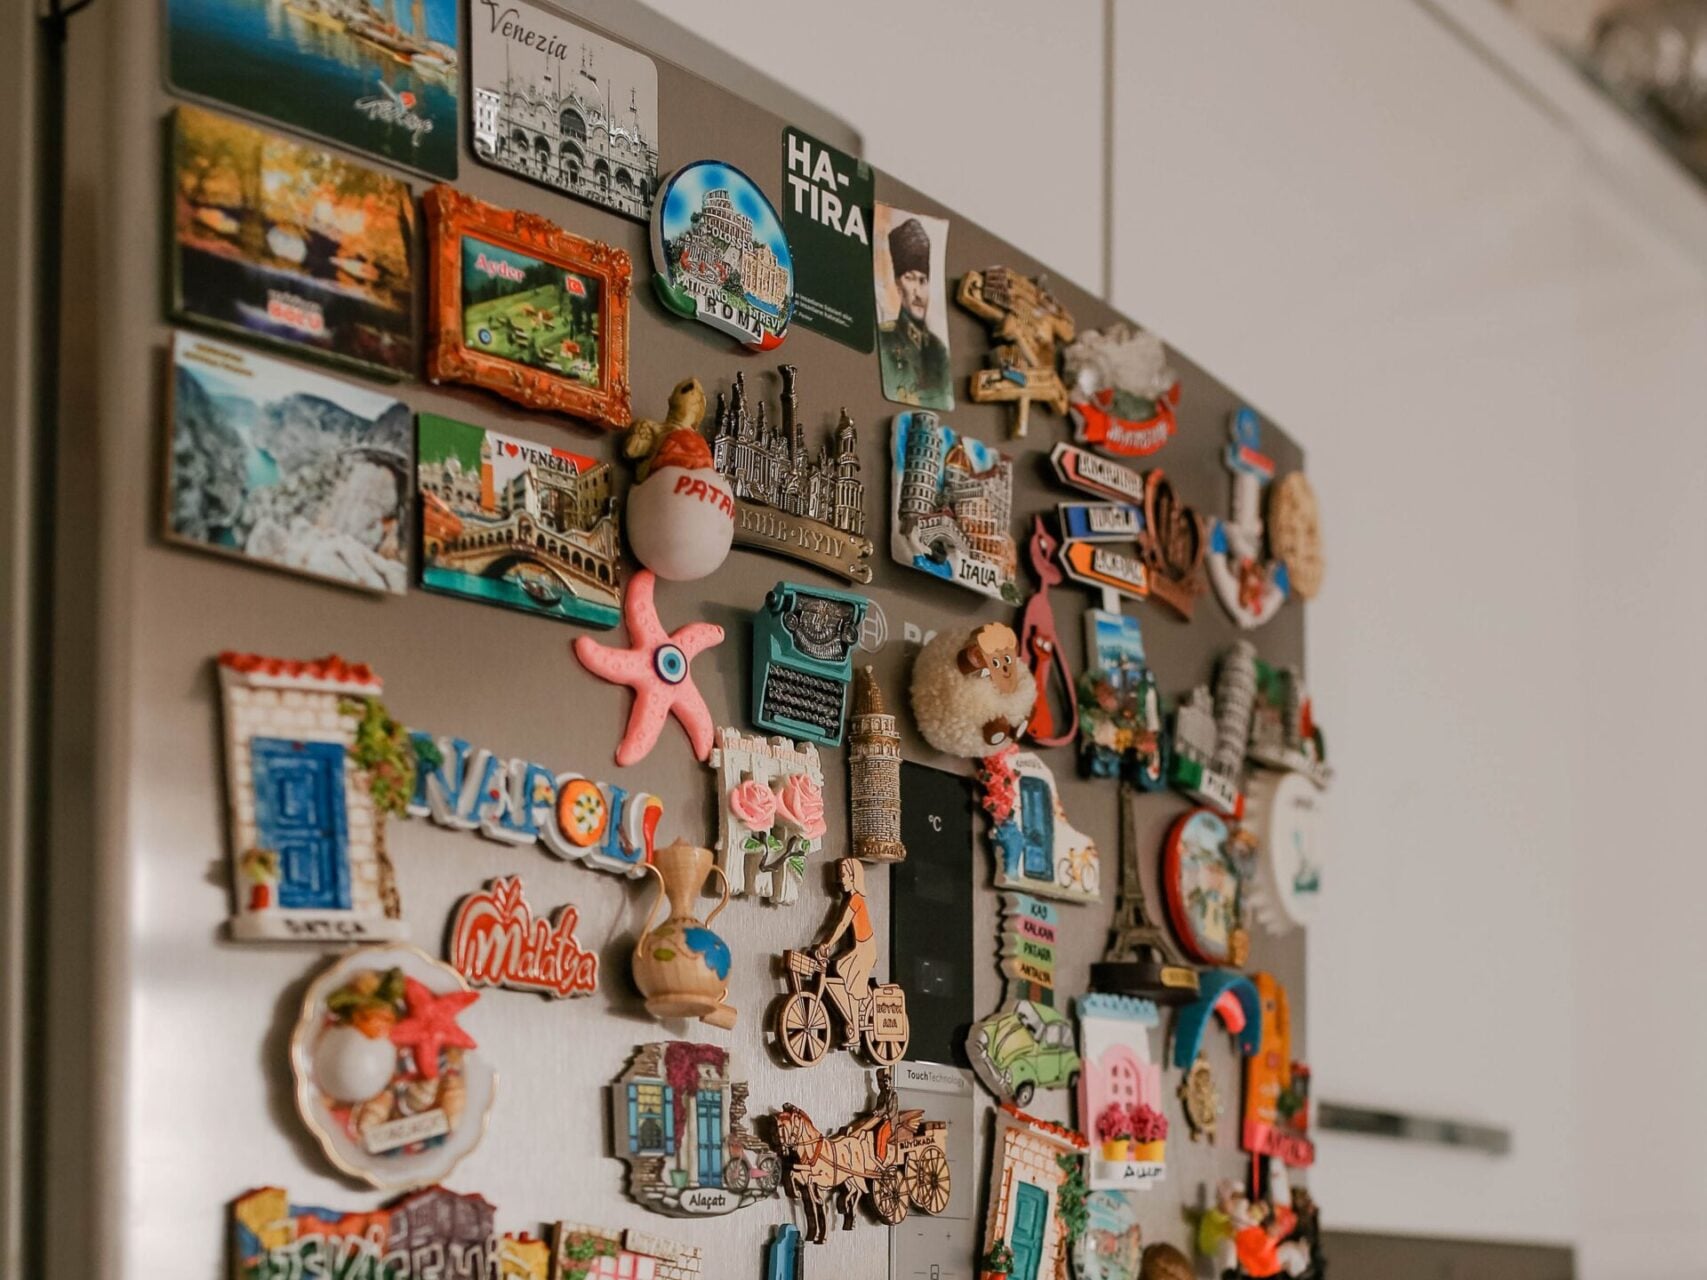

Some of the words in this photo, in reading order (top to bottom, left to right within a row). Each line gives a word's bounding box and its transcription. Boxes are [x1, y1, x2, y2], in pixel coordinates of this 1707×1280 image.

[481, 0, 567, 60] Venezia
[788, 134, 849, 191] HA-
[788, 173, 869, 245] TIRA
[475, 253, 526, 284] Ayder
[704, 297, 762, 338] ROMA
[496, 440, 504, 456] I
[520, 446, 579, 477] VENEZIA
[798, 526, 845, 558] KYIV
[959, 558, 999, 588] ITALIA
[459, 896, 596, 992] Malatya
